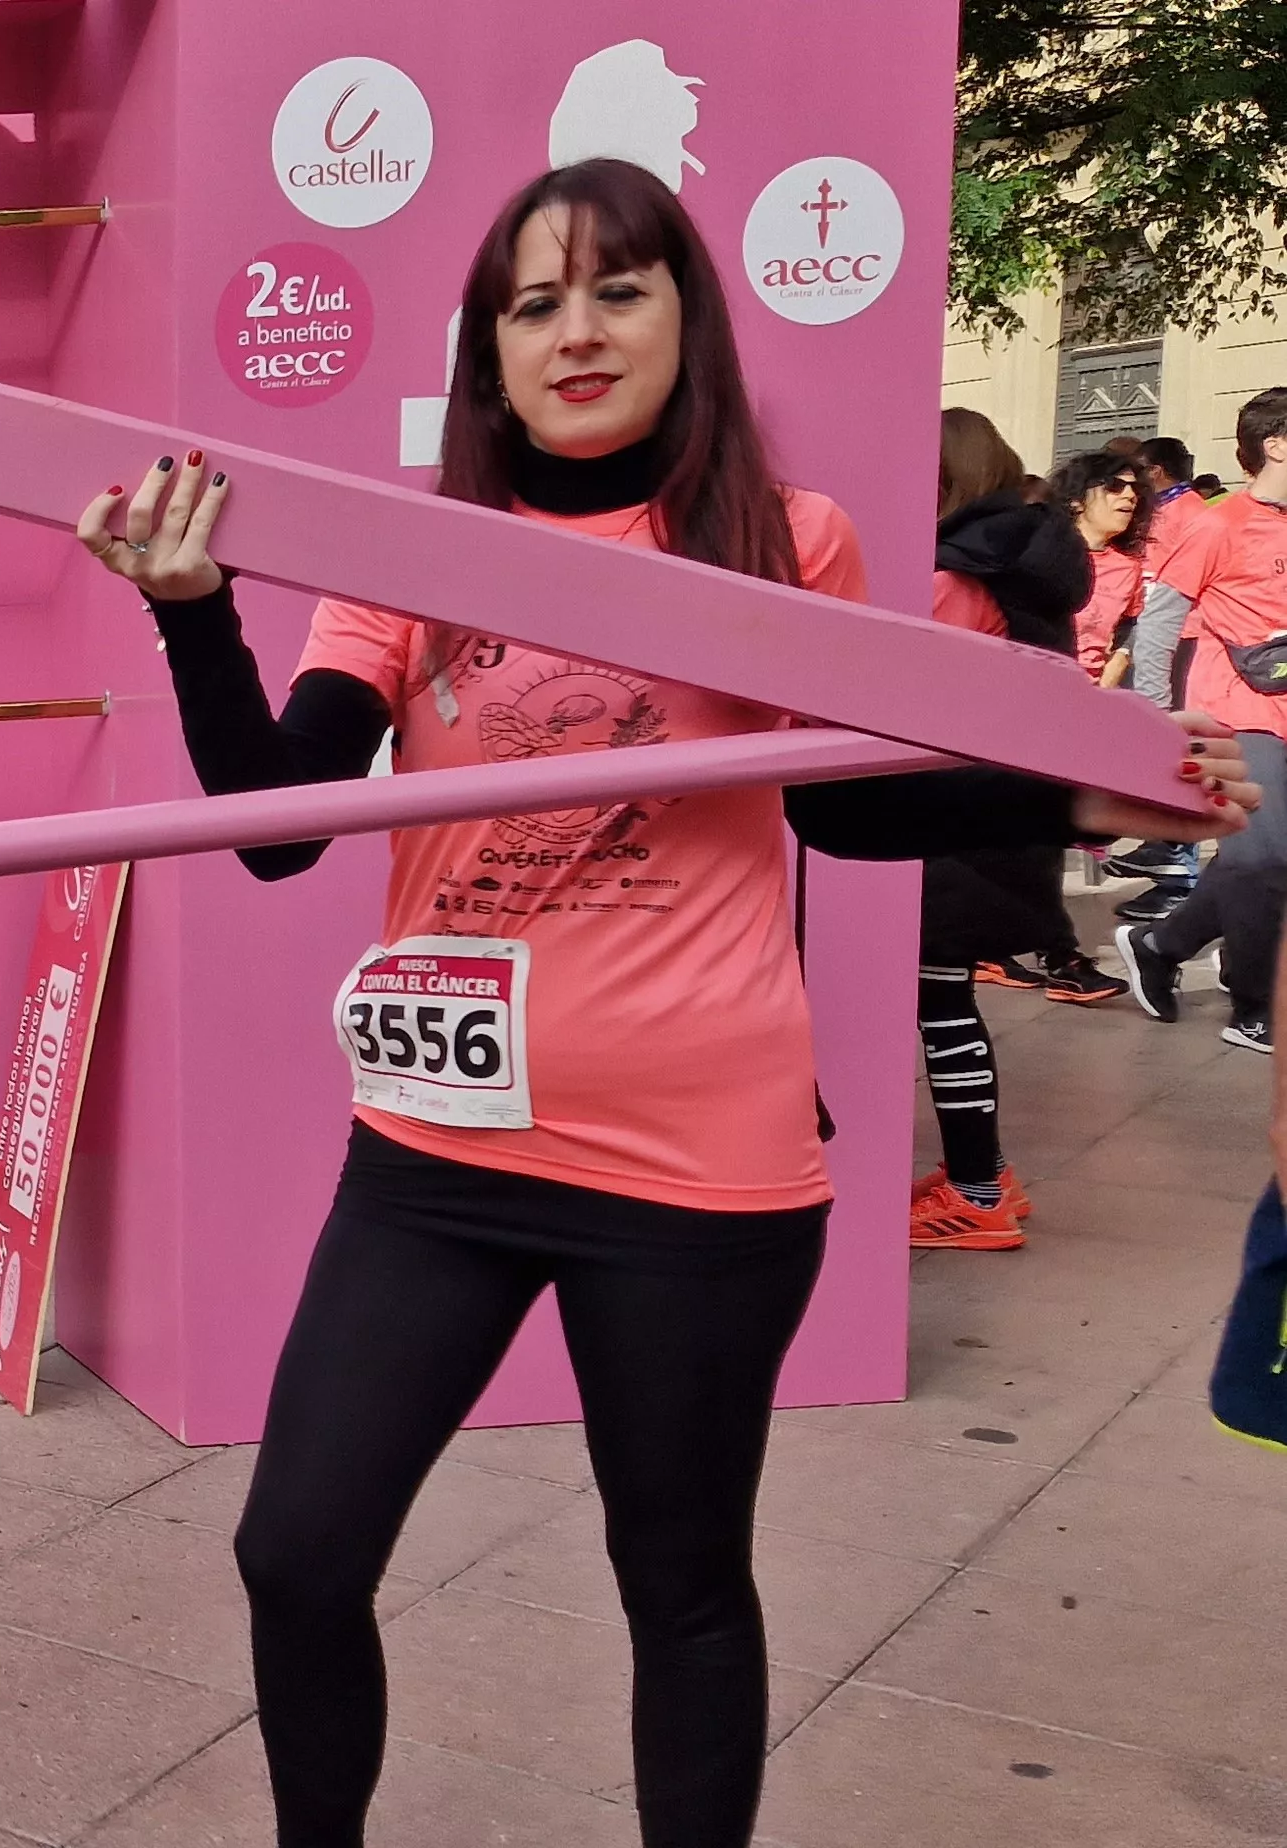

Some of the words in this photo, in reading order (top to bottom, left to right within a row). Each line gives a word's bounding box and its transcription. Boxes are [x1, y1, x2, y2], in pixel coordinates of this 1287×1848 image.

[288, 150, 416, 188] castellar
[763, 254, 881, 287] aecc
[246, 261, 352, 318] 2€/ud.
[779, 287, 812, 298] Contra
[816, 286, 824, 296] el
[830, 286, 863, 297] Cáncer
[238, 330, 250, 346] a
[257, 321, 352, 345] beneficio
[245, 350, 345, 379] aecc
[1275, 558, 1285, 575] 9
[473, 638, 505, 669] 9
[74, 866, 95, 941] castell
[397, 959, 438, 973] HUESCA
[362, 974, 404, 991] CONTRA
[407, 976, 424, 992] EL
[426, 972, 499, 996] CÁNCER
[51, 1076, 64, 1120] PARA
[70, 951, 88, 1019] HUESCA
[349, 1003, 501, 1079] 3556
[4, 1062, 19, 1111] todos
[13, 996, 32, 1056] hemos
[3, 1081, 26, 1189] conseguido
[22, 1007, 41, 1078] superar
[35, 978, 47, 1005] los
[16, 1033, 58, 1197] 50.000
[49, 984, 69, 1012] €
